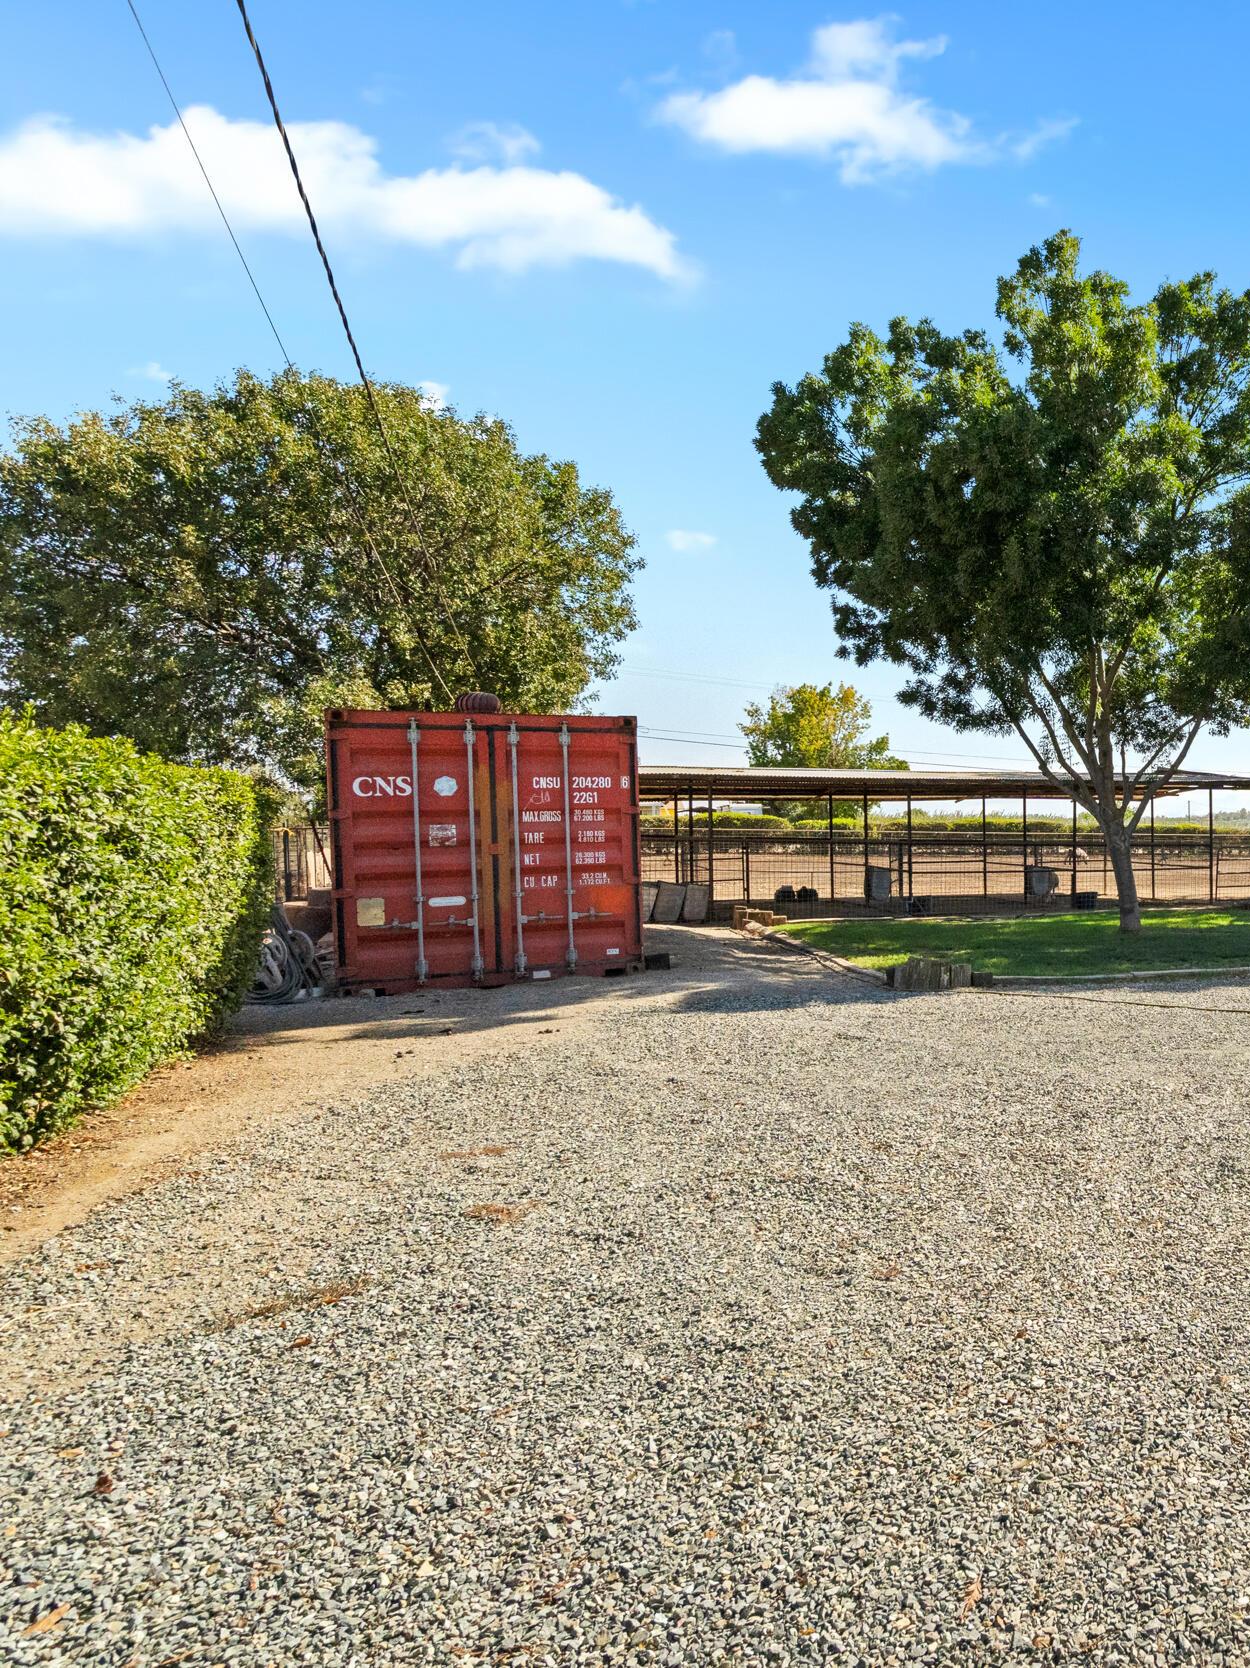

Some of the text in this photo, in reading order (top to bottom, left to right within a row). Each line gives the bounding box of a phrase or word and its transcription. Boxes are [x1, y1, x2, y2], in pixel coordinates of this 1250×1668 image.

[352, 776, 412, 797] CNS
[533, 776, 629, 789] CNSU 204280 6
[573, 791, 598, 804] 22G1
[523, 832, 545, 844] TARE
[524, 853, 540, 865] NET
[541, 875, 558, 887] CAP
